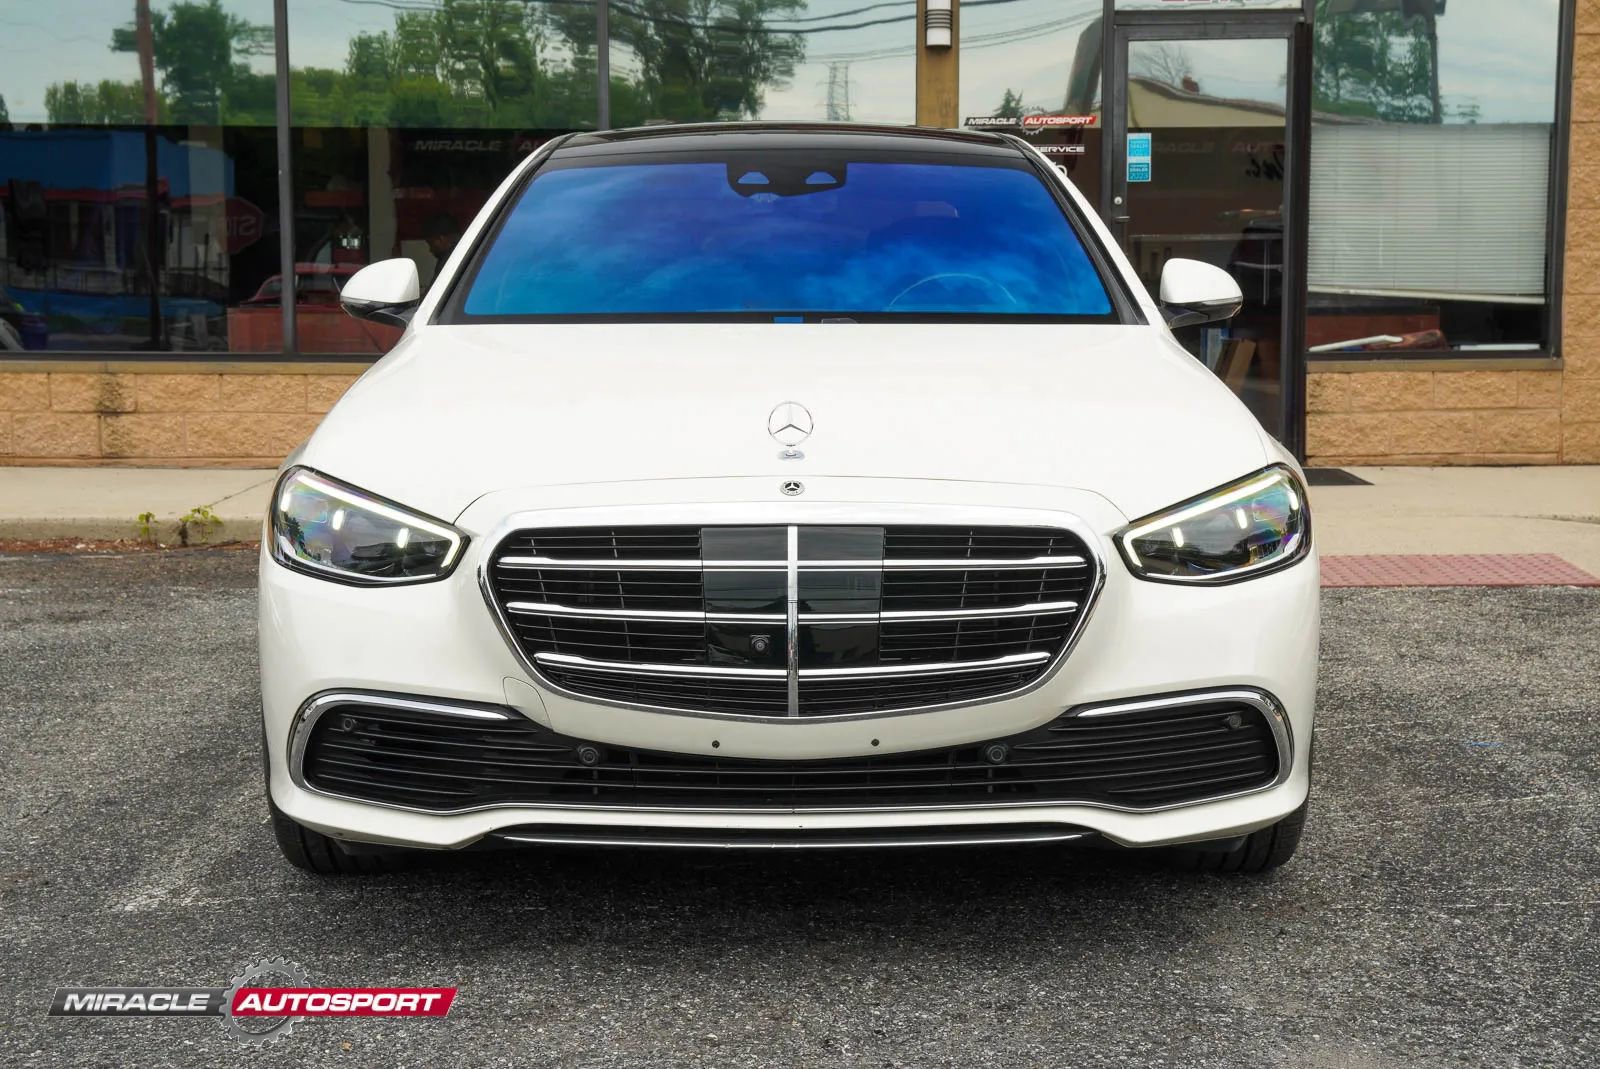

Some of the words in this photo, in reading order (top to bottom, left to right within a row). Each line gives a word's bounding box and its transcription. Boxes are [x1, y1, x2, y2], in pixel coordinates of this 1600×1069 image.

[967, 117, 1018, 125] MIRACLE
[1024, 116, 1093, 125] AUTOSPORT
[414, 140, 503, 151] MIRACLE
